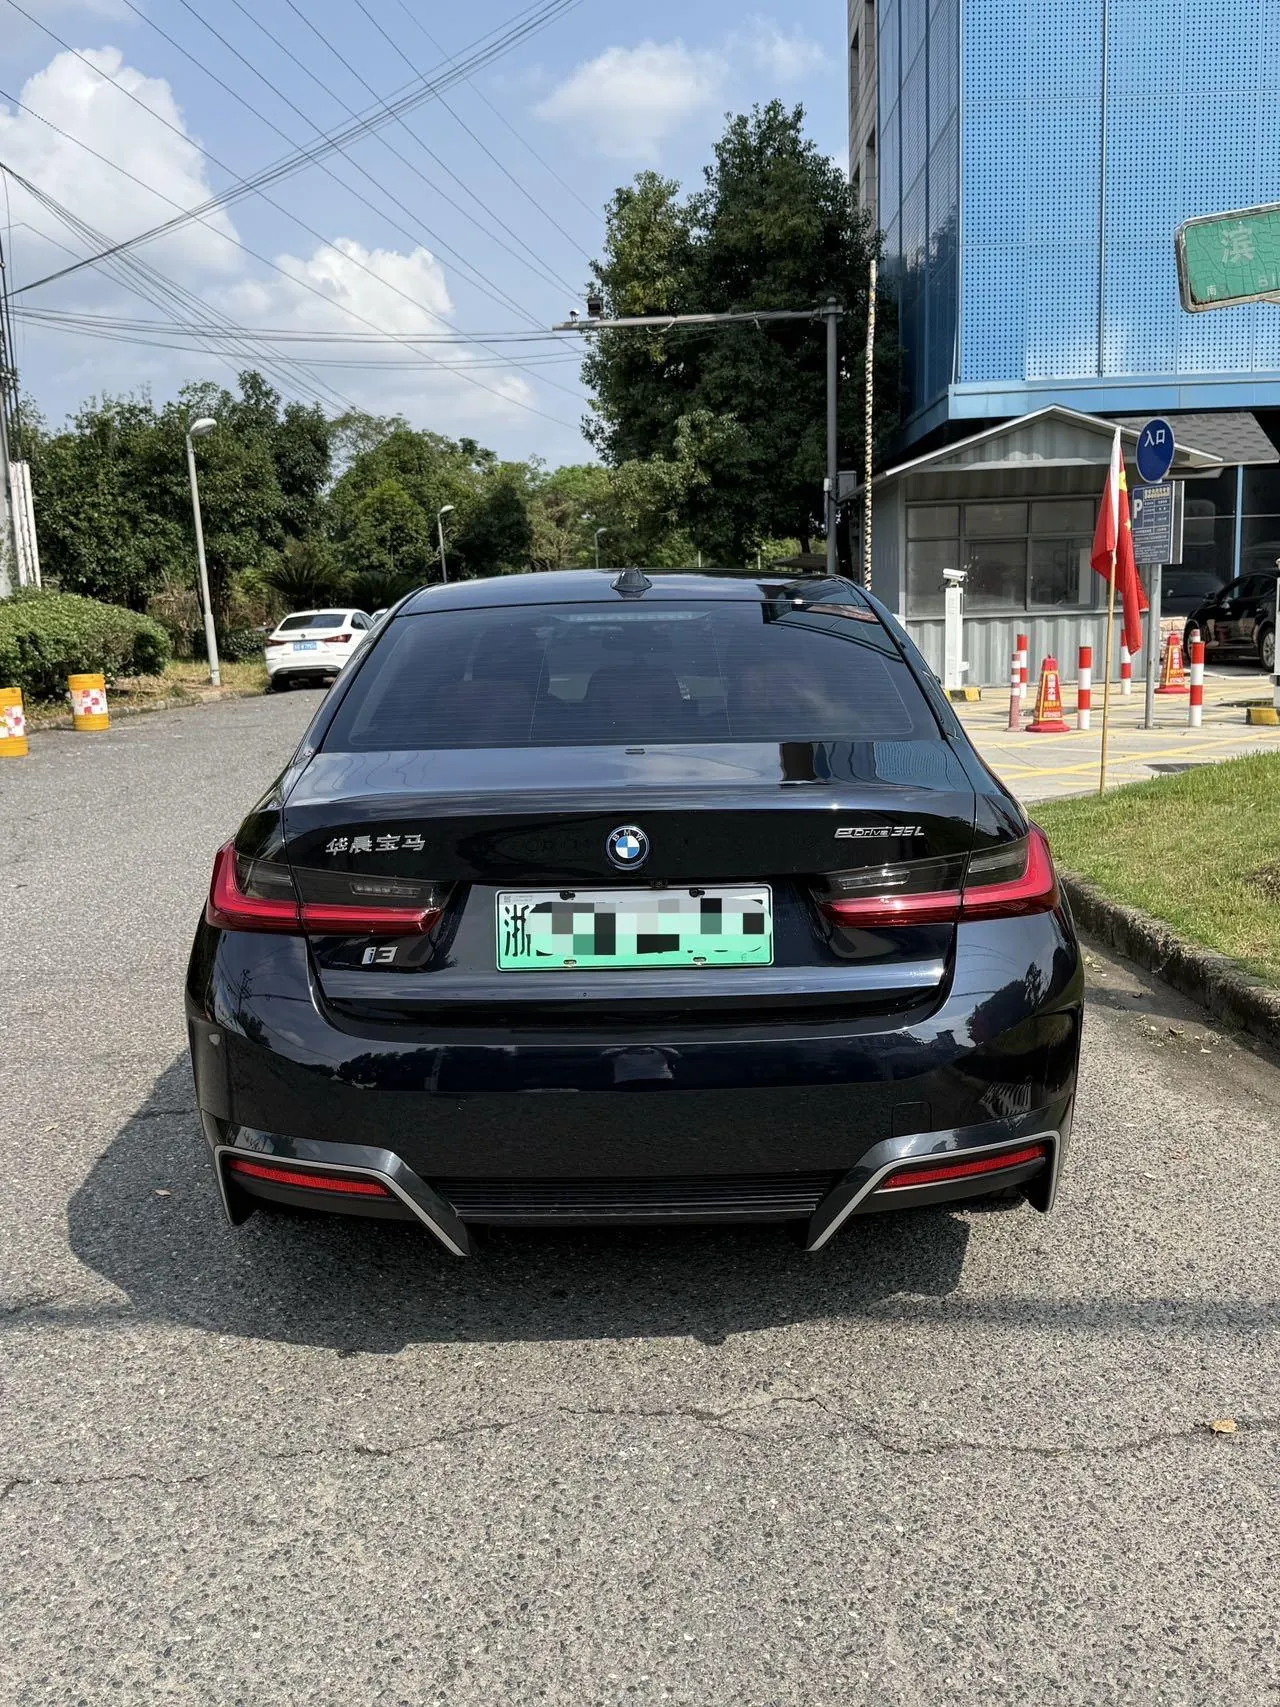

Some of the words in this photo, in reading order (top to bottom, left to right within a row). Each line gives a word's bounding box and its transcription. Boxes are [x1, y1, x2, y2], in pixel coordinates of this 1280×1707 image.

[1221, 221, 1255, 264] 滨
[1259, 273, 1280, 289] BI
[1144, 429, 1166, 448] 入口
[1133, 499, 1143, 519] P
[612, 829, 645, 842] BMW
[891, 826, 925, 837] 35L
[325, 834, 426, 856] 华晨宝马
[362, 946, 398, 965] i3
